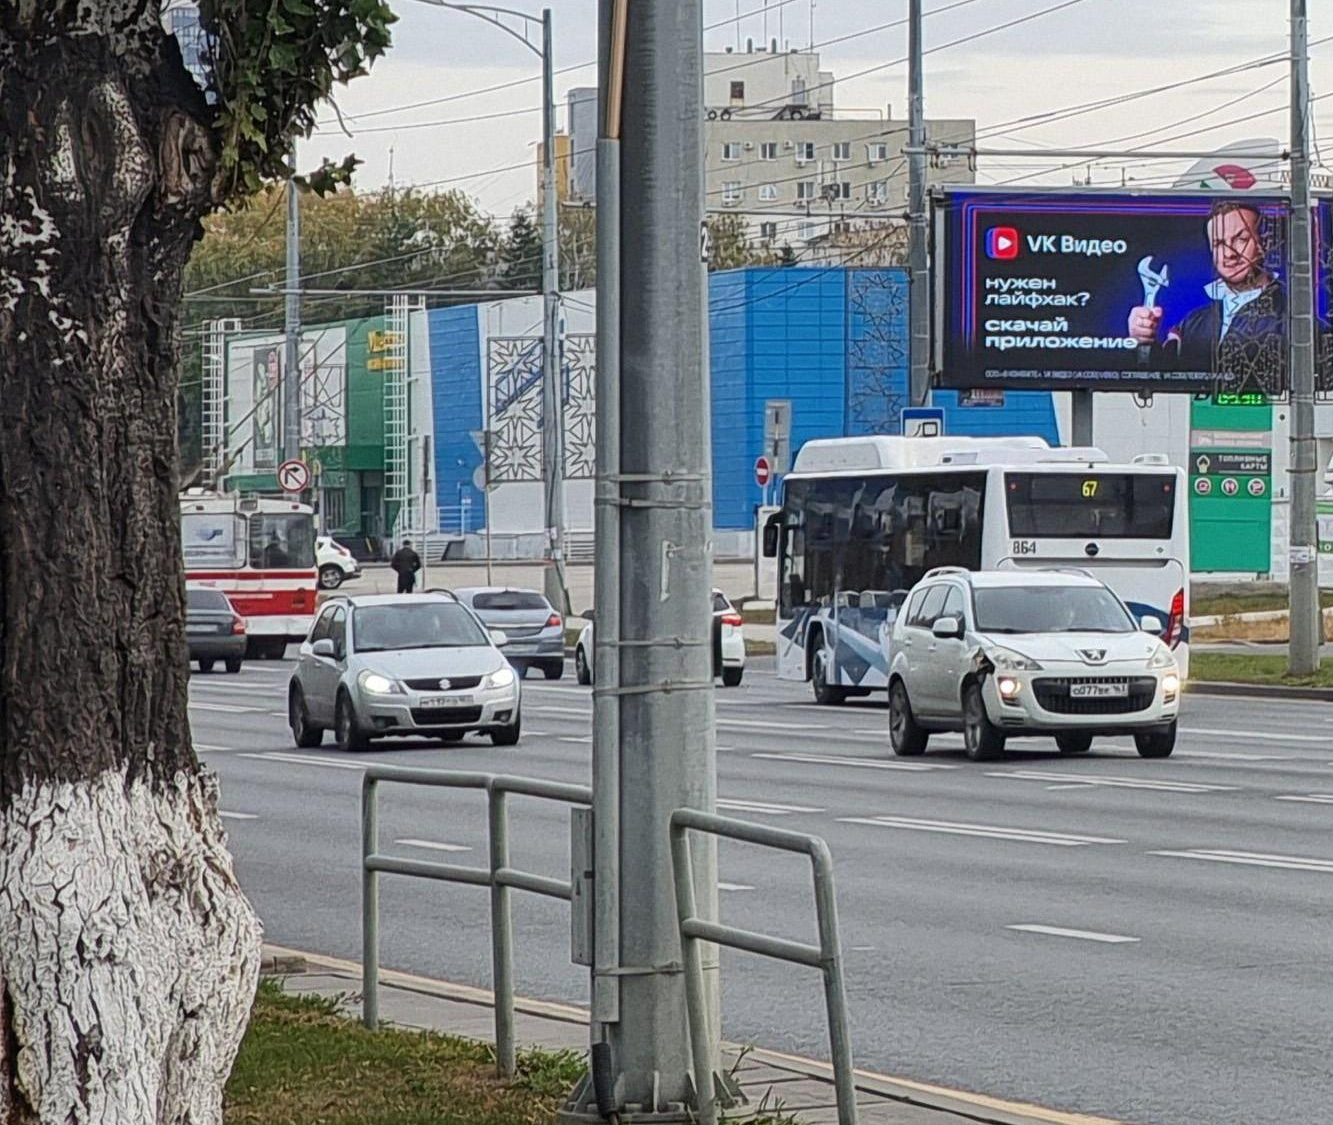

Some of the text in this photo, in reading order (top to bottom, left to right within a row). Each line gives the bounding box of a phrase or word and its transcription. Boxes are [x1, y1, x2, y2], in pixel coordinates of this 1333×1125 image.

[1026, 236, 1127, 256] VK Видео
[985, 277, 1056, 292] нужен
[985, 292, 1090, 308] лайфхак?
[985, 317, 1068, 332] скачай
[985, 336, 1138, 351] приложение
[1082, 480, 1098, 497] 67
[1012, 541, 1036, 555] 864
